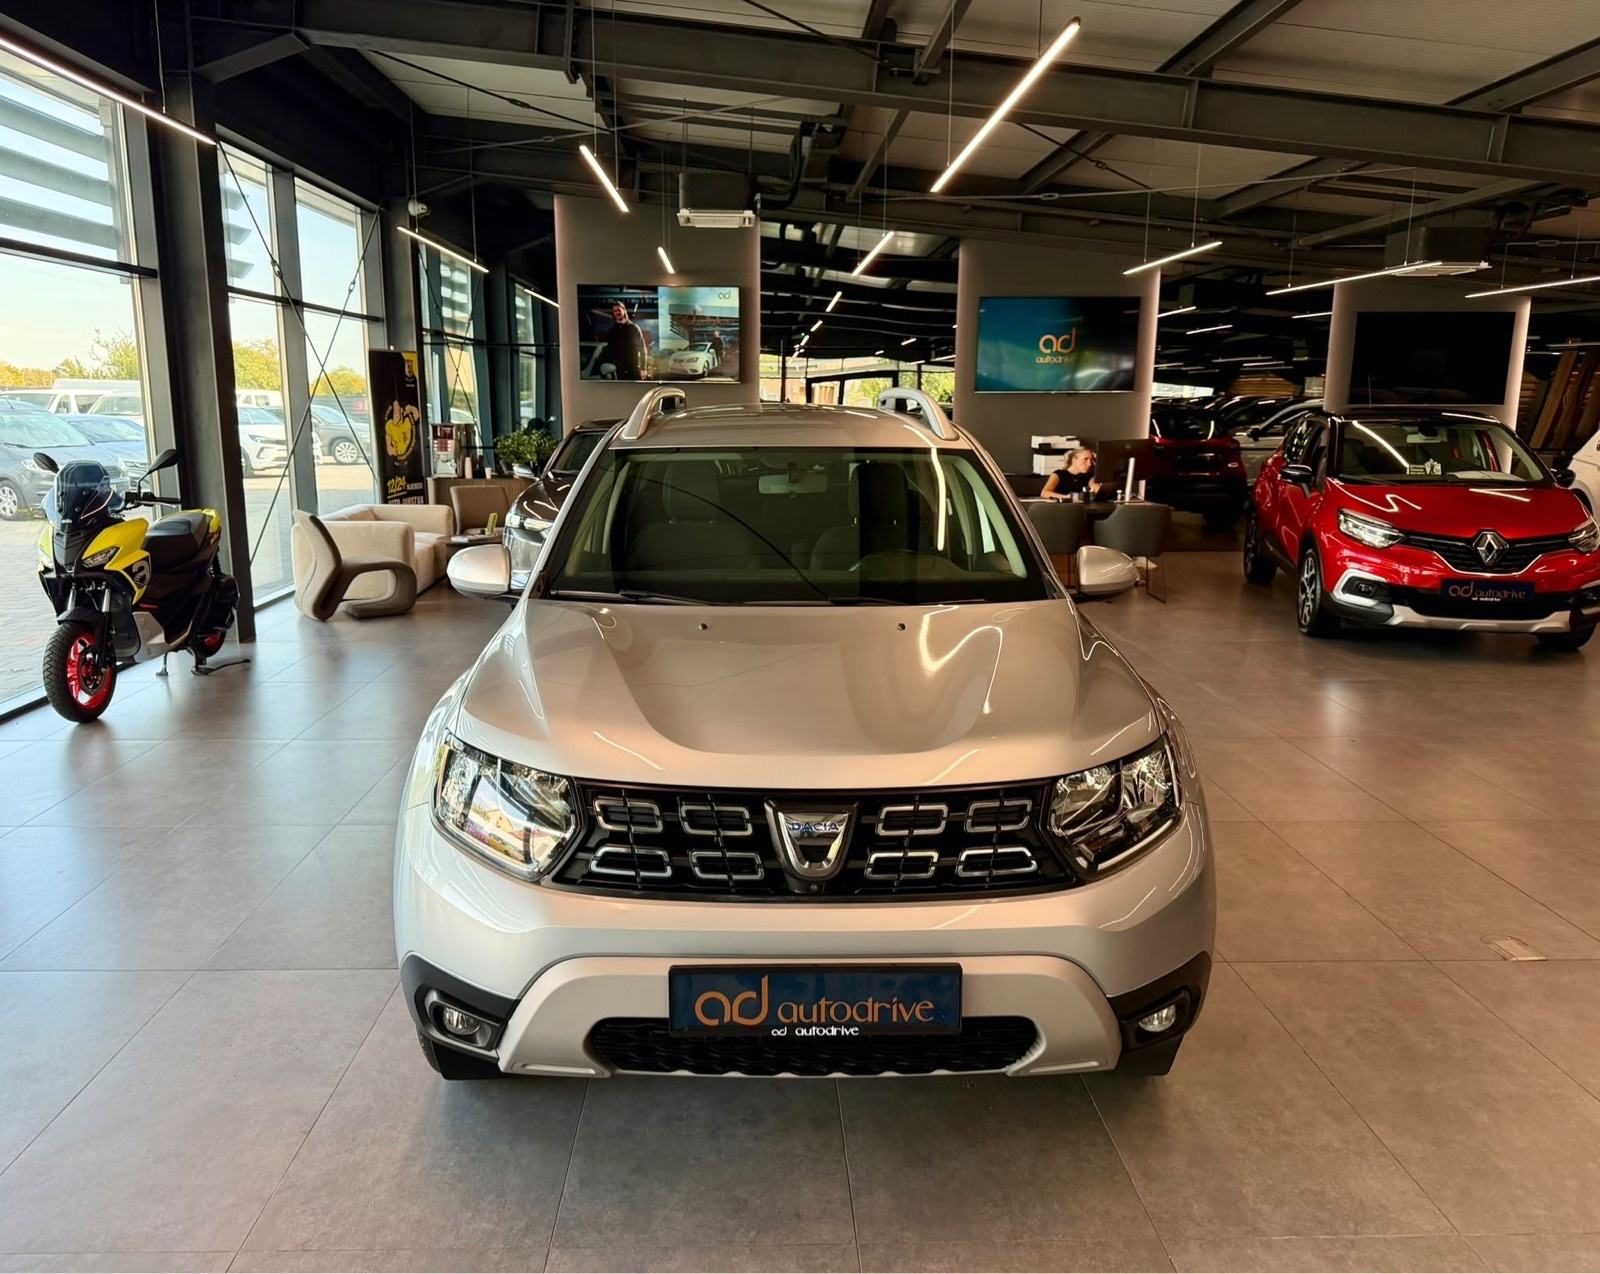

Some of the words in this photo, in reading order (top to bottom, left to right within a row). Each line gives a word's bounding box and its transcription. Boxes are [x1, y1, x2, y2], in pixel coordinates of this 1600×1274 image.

[1039, 327, 1076, 353] ad
[1036, 355, 1073, 364] autodr
[387, 475, 407, 494] 12/24
[1448, 581, 1474, 597] ad
[790, 822, 839, 831] DACIA
[694, 975, 769, 1026] ad
[777, 996, 935, 1023] autodrive
[771, 1026, 788, 1037] ad
[795, 1026, 860, 1037] autodrive
